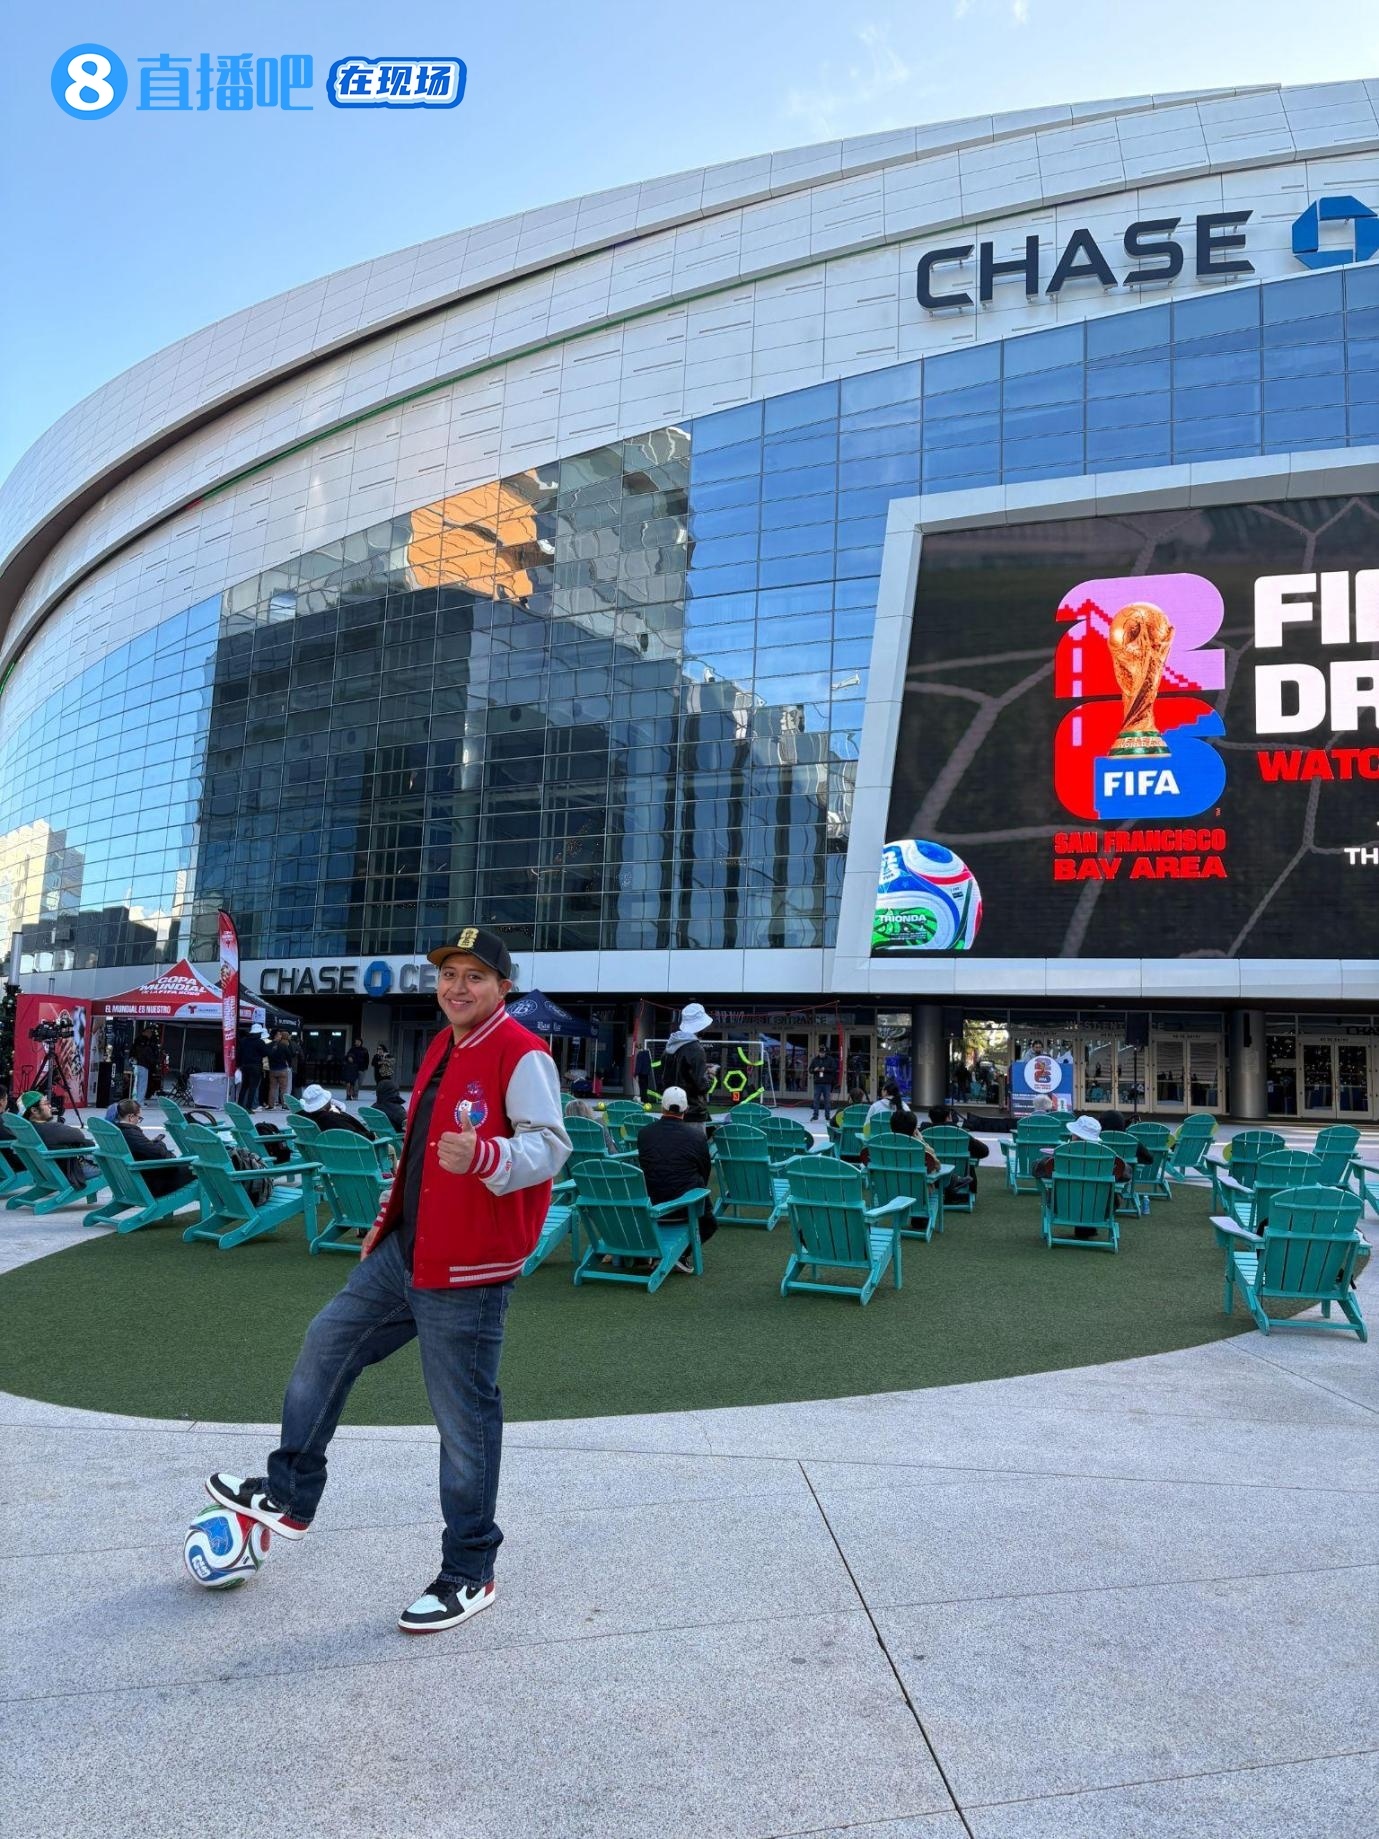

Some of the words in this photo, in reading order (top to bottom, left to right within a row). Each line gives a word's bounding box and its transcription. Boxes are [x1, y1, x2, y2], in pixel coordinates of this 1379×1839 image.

[916, 209, 1255, 312] CHASE
[1255, 659, 1379, 735] DR
[1103, 769, 1180, 798] FIFA
[1054, 830, 1099, 853] SAN
[1103, 828, 1226, 852] FRANCISCO
[1054, 859, 1121, 880] BAY
[1130, 857, 1227, 879] AREA
[879, 914, 927, 923] TRIONDA
[139, 983, 207, 993] MUNDIAL
[157, 976, 197, 985] COPA
[260, 965, 356, 994] CHASE
[105, 1005, 112, 1013] EL
[114, 1005, 136, 1013] MUNDIAL
[138, 1005, 146, 1013] ES
[147, 1005, 171, 1013] NUESTRO
